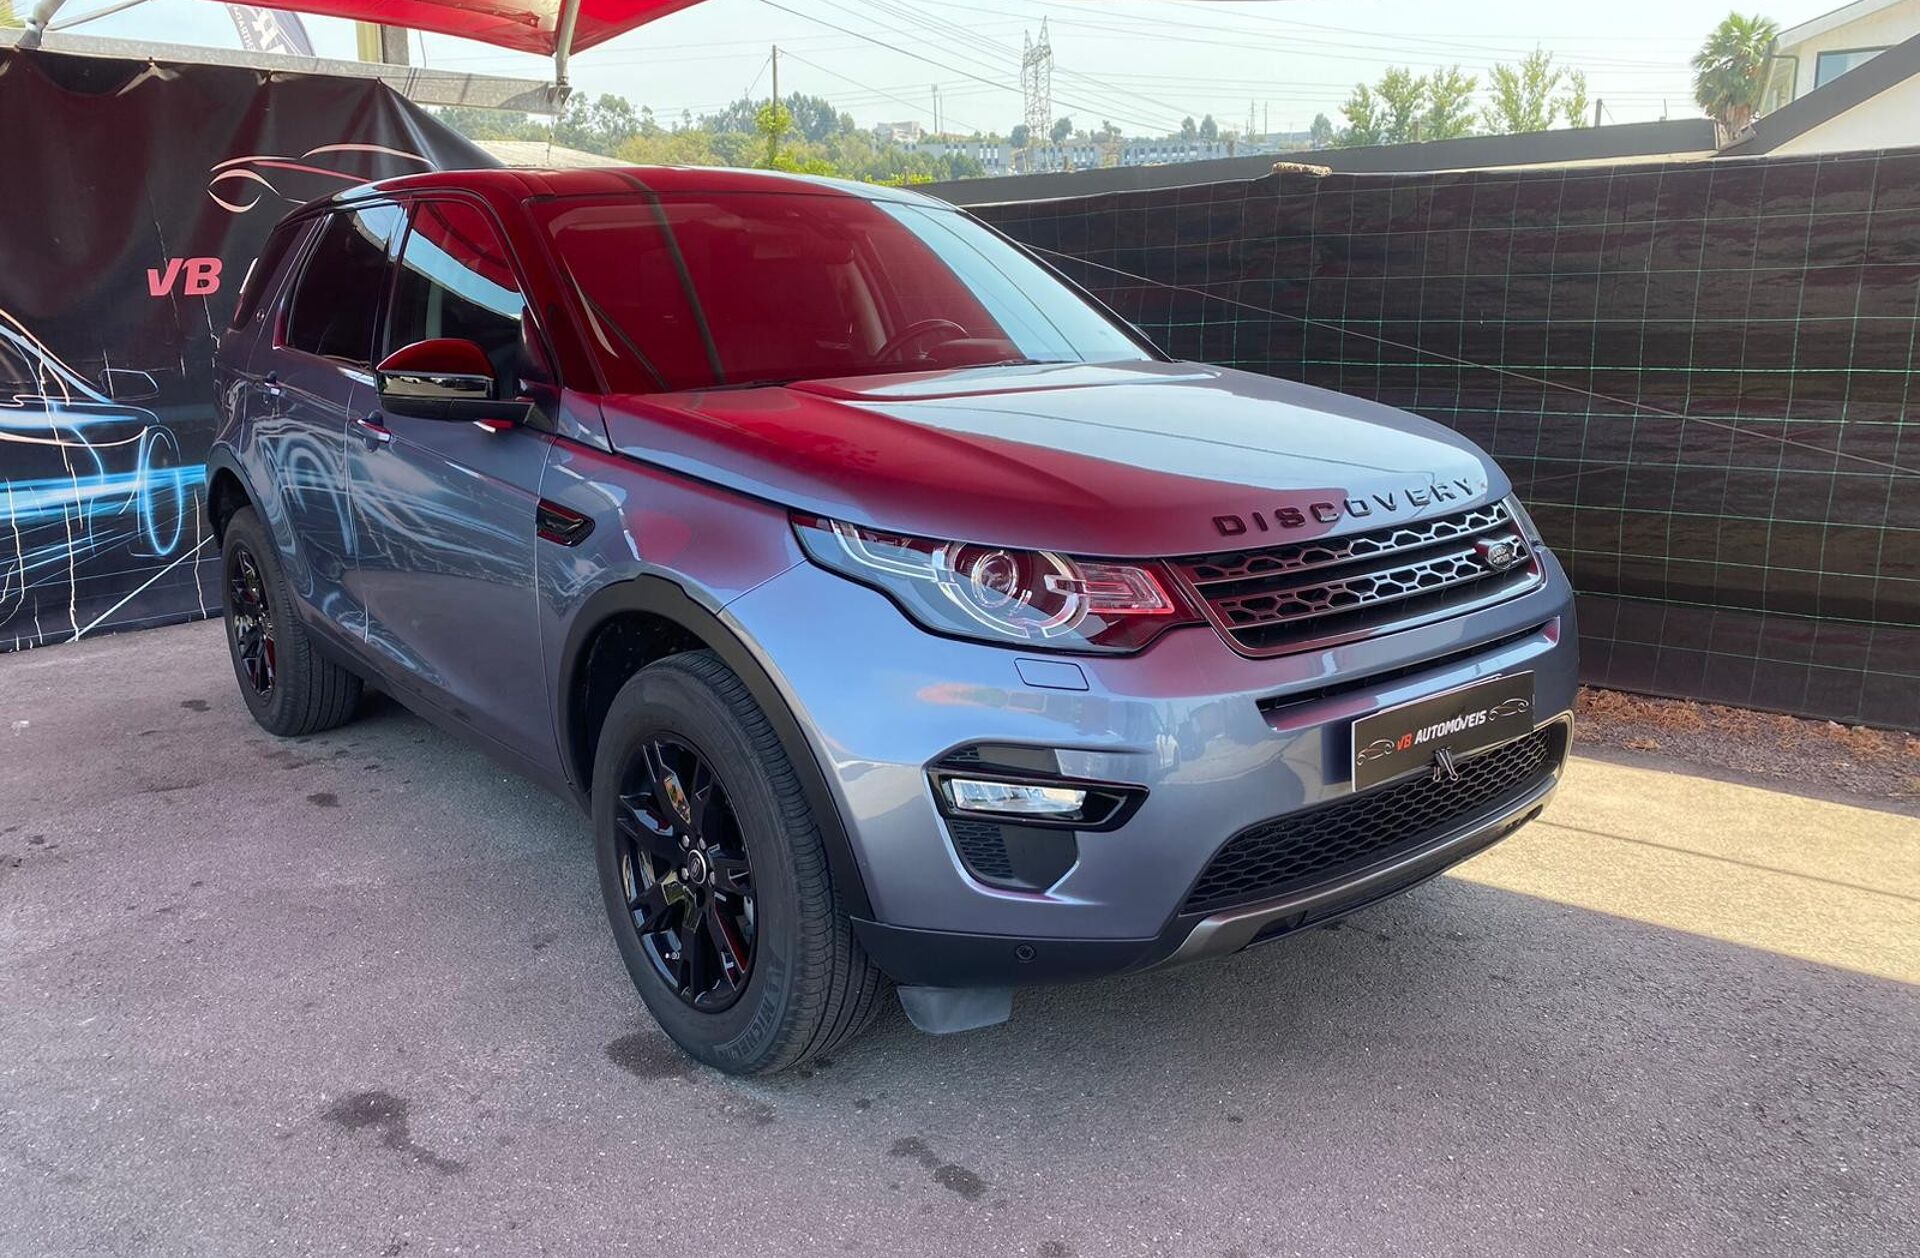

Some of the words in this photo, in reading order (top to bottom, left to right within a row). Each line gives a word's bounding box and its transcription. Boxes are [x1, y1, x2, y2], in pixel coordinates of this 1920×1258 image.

[147, 257, 223, 296] VB
[1212, 478, 1474, 536] DISCOVERY
[1396, 733, 1413, 750] VB
[1414, 710, 1487, 744] AUTOMÓVEIS
